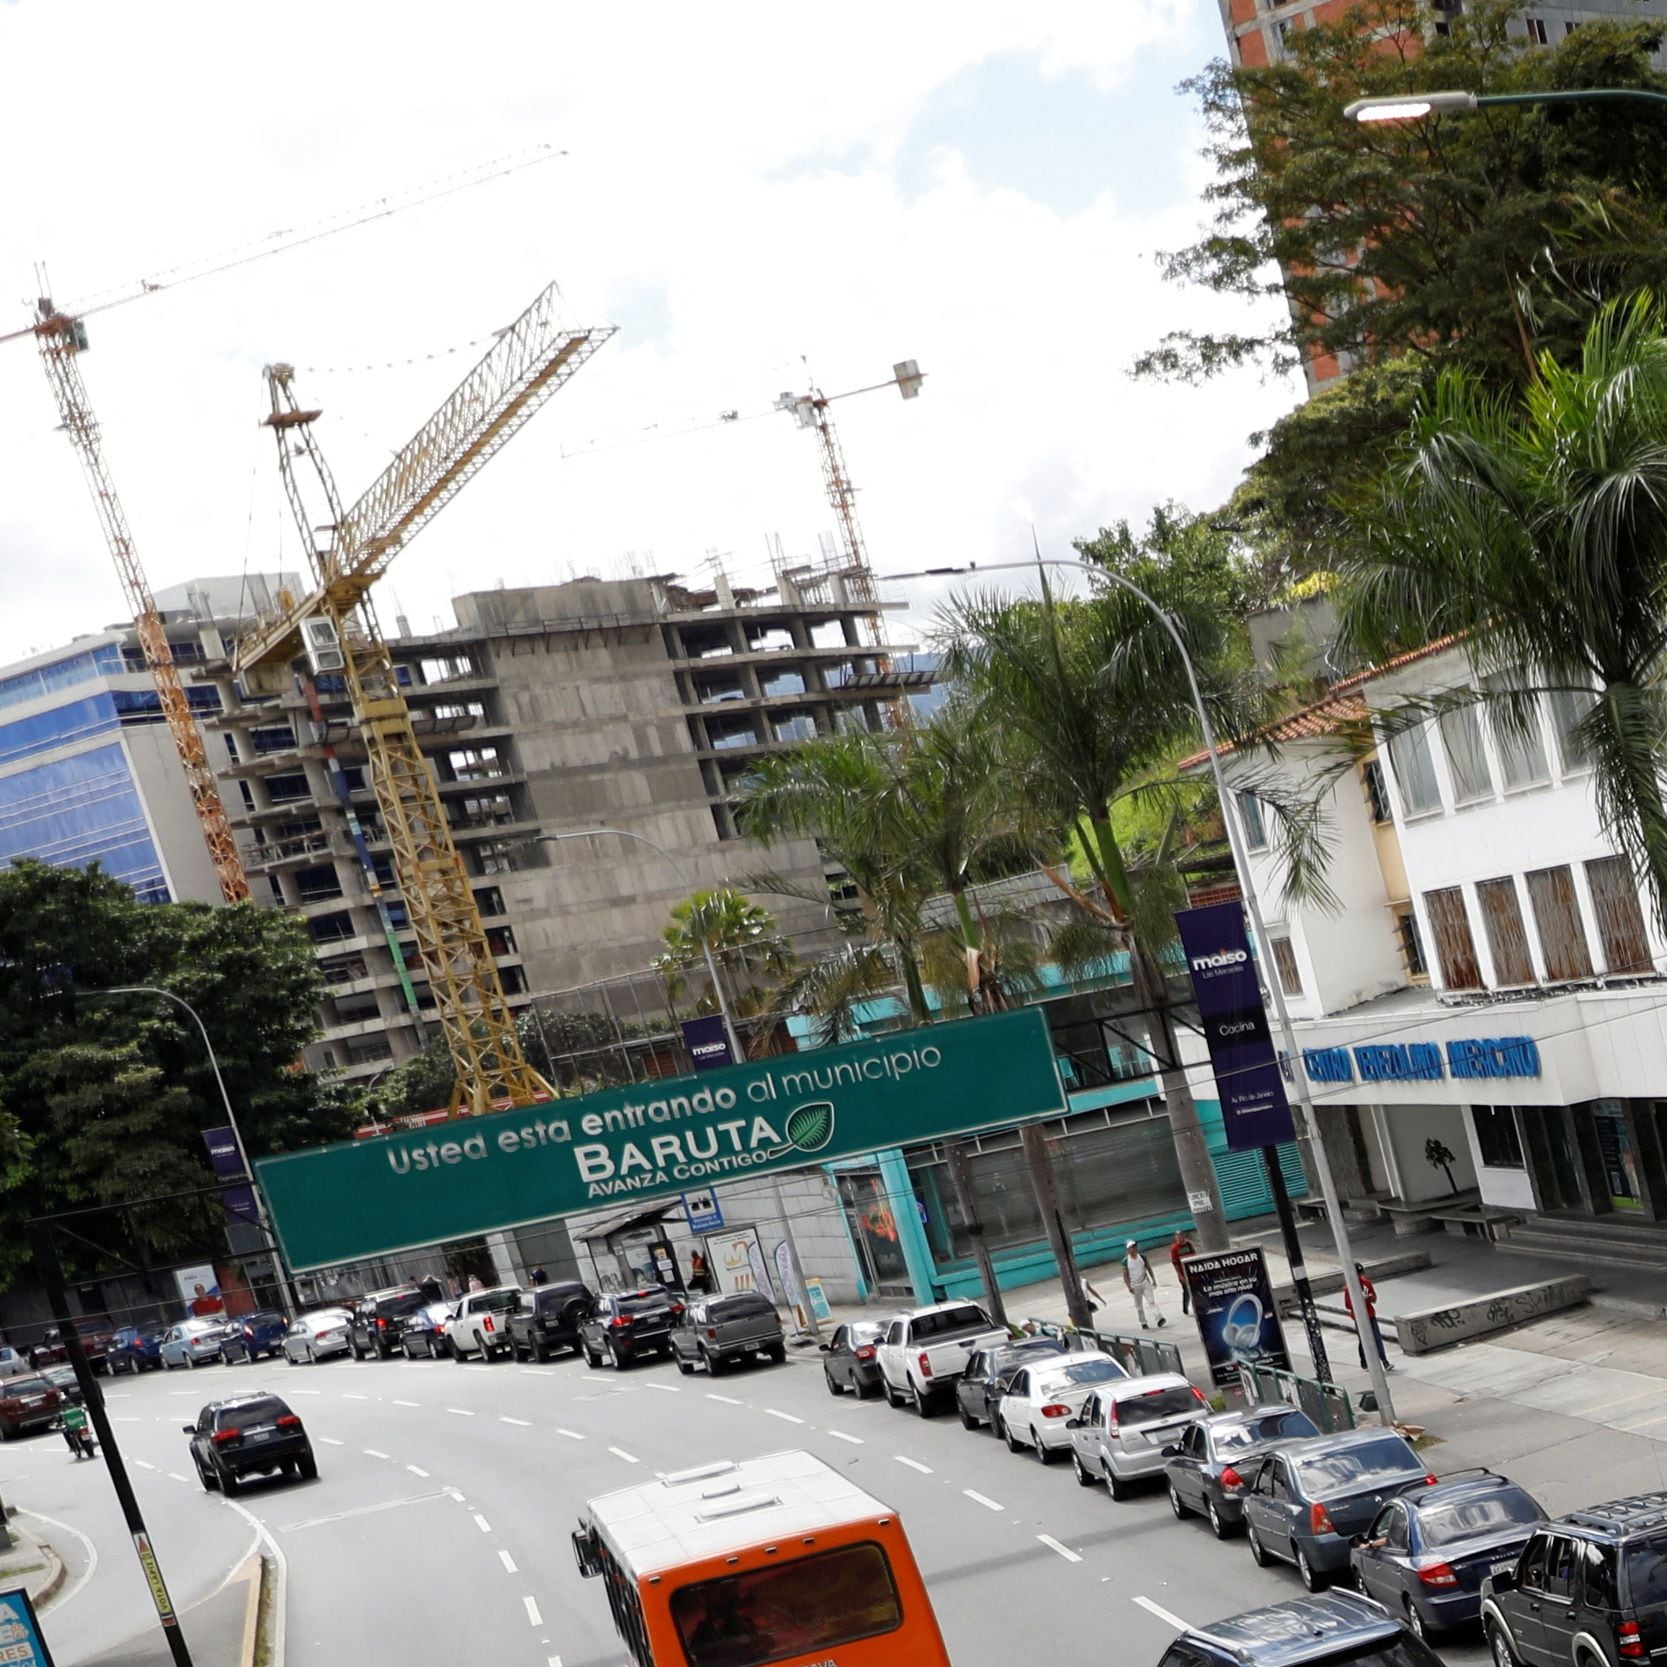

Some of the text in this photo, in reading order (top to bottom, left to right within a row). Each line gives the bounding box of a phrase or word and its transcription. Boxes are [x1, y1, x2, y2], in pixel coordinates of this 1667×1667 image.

[1192, 949, 1247, 972] maiso
[1219, 1020, 1255, 1037] Cocina
[386, 1044, 943, 1175] Usted esta entrando al municipio
[573, 1116, 781, 1184] BARUTA
[587, 1150, 770, 1198] AVANZA CONTIGO
[1190, 1253, 1258, 1274] NAIDA HOGAR
